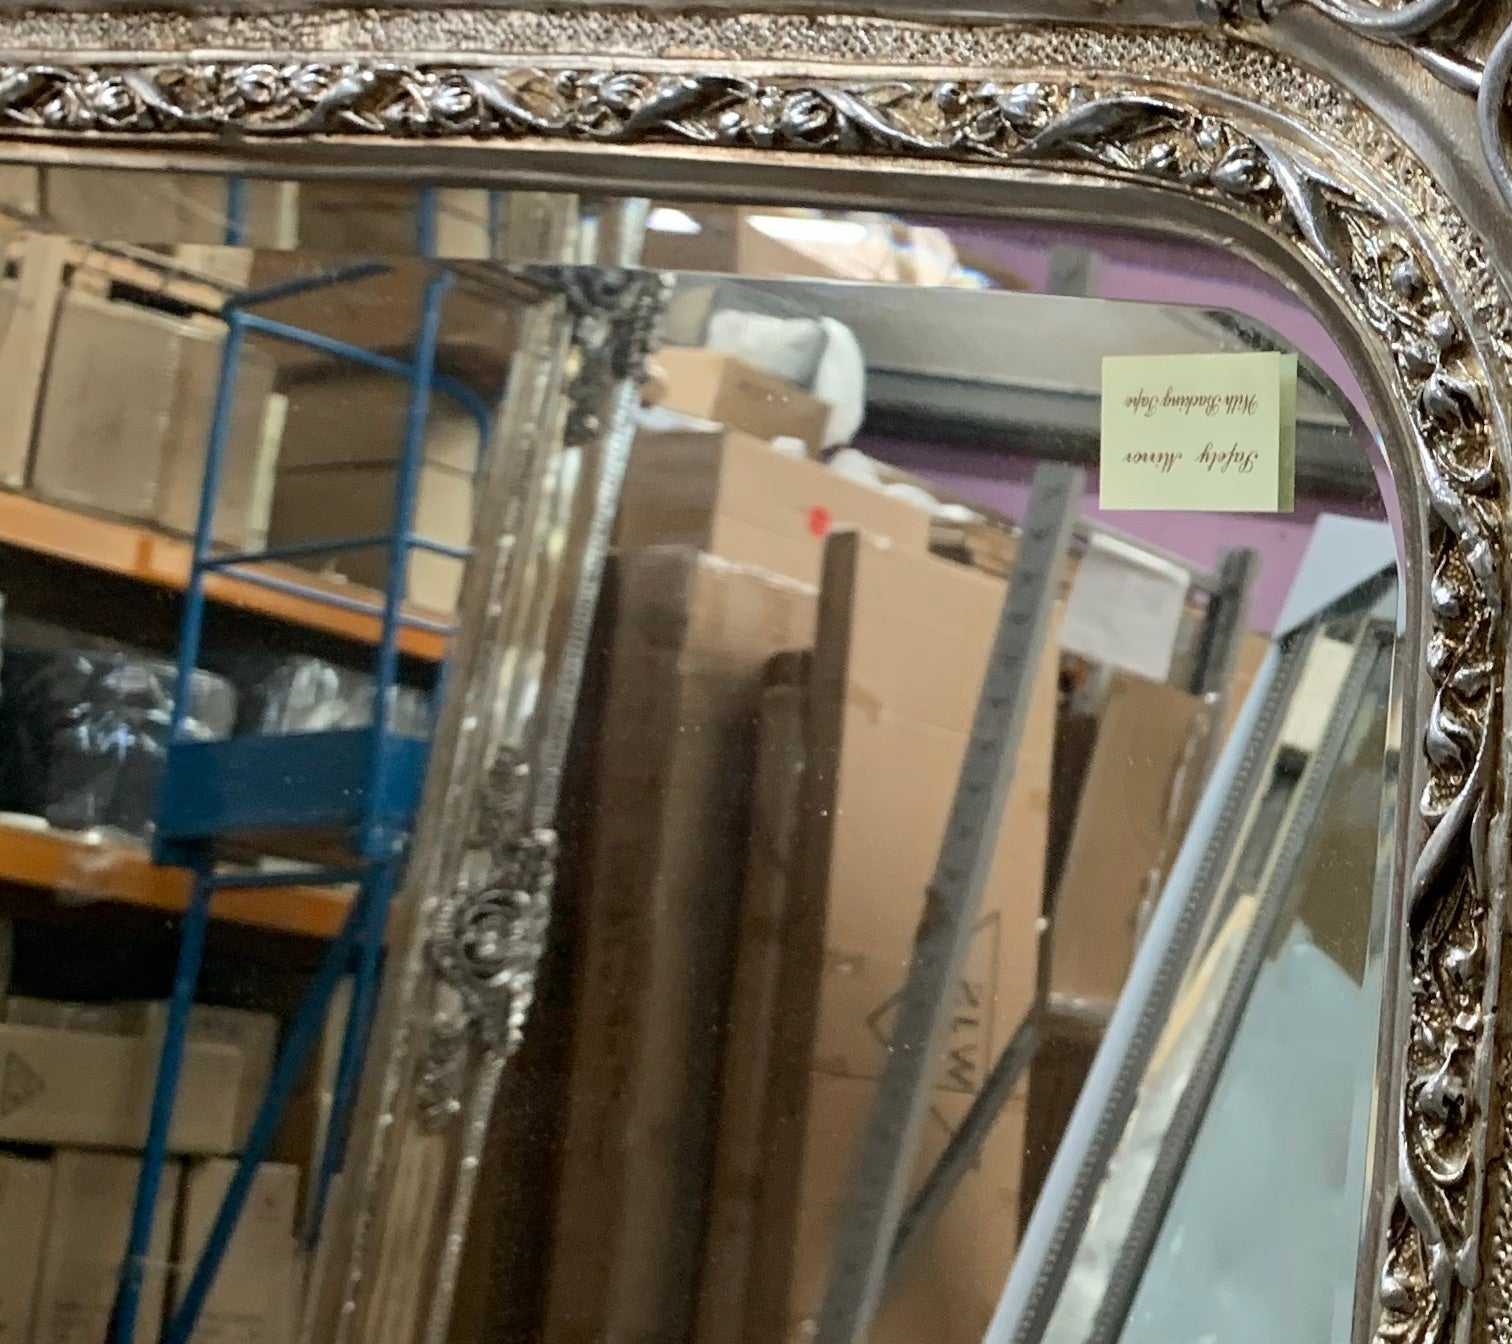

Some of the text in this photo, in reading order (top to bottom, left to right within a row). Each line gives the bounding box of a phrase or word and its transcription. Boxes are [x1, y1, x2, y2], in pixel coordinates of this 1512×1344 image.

[1123, 386, 1259, 418] With Backing Tape
[1122, 441, 1259, 474] Safety Mirror
